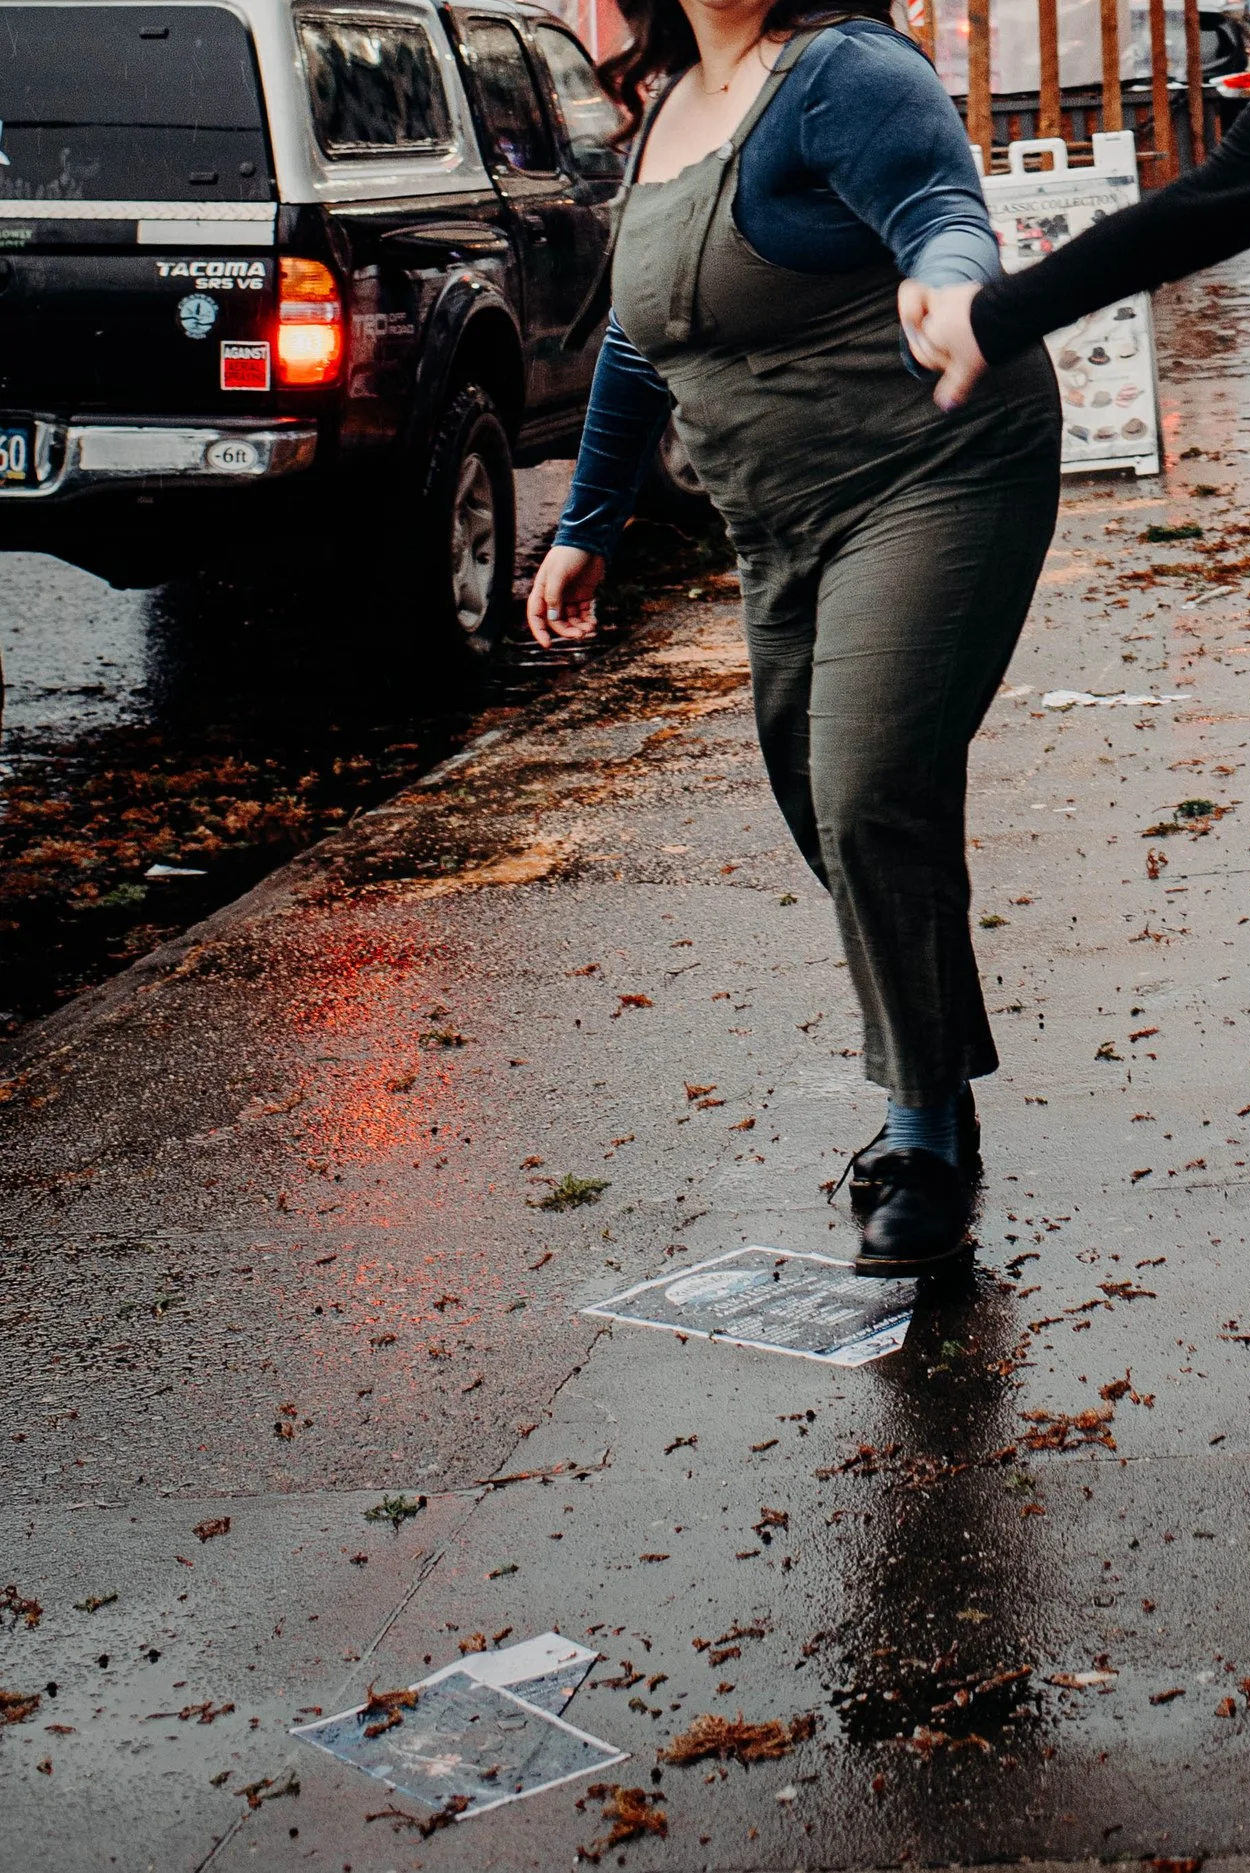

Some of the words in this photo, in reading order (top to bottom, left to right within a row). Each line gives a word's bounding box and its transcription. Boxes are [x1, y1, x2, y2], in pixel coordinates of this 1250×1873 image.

[1041, 193, 1118, 211] COLLECTION
[156, 261, 266, 277] TACOMA
[238, 278, 263, 290] V6
[223, 346, 267, 359] AGAINST
[215, 447, 248, 465] -6ft
